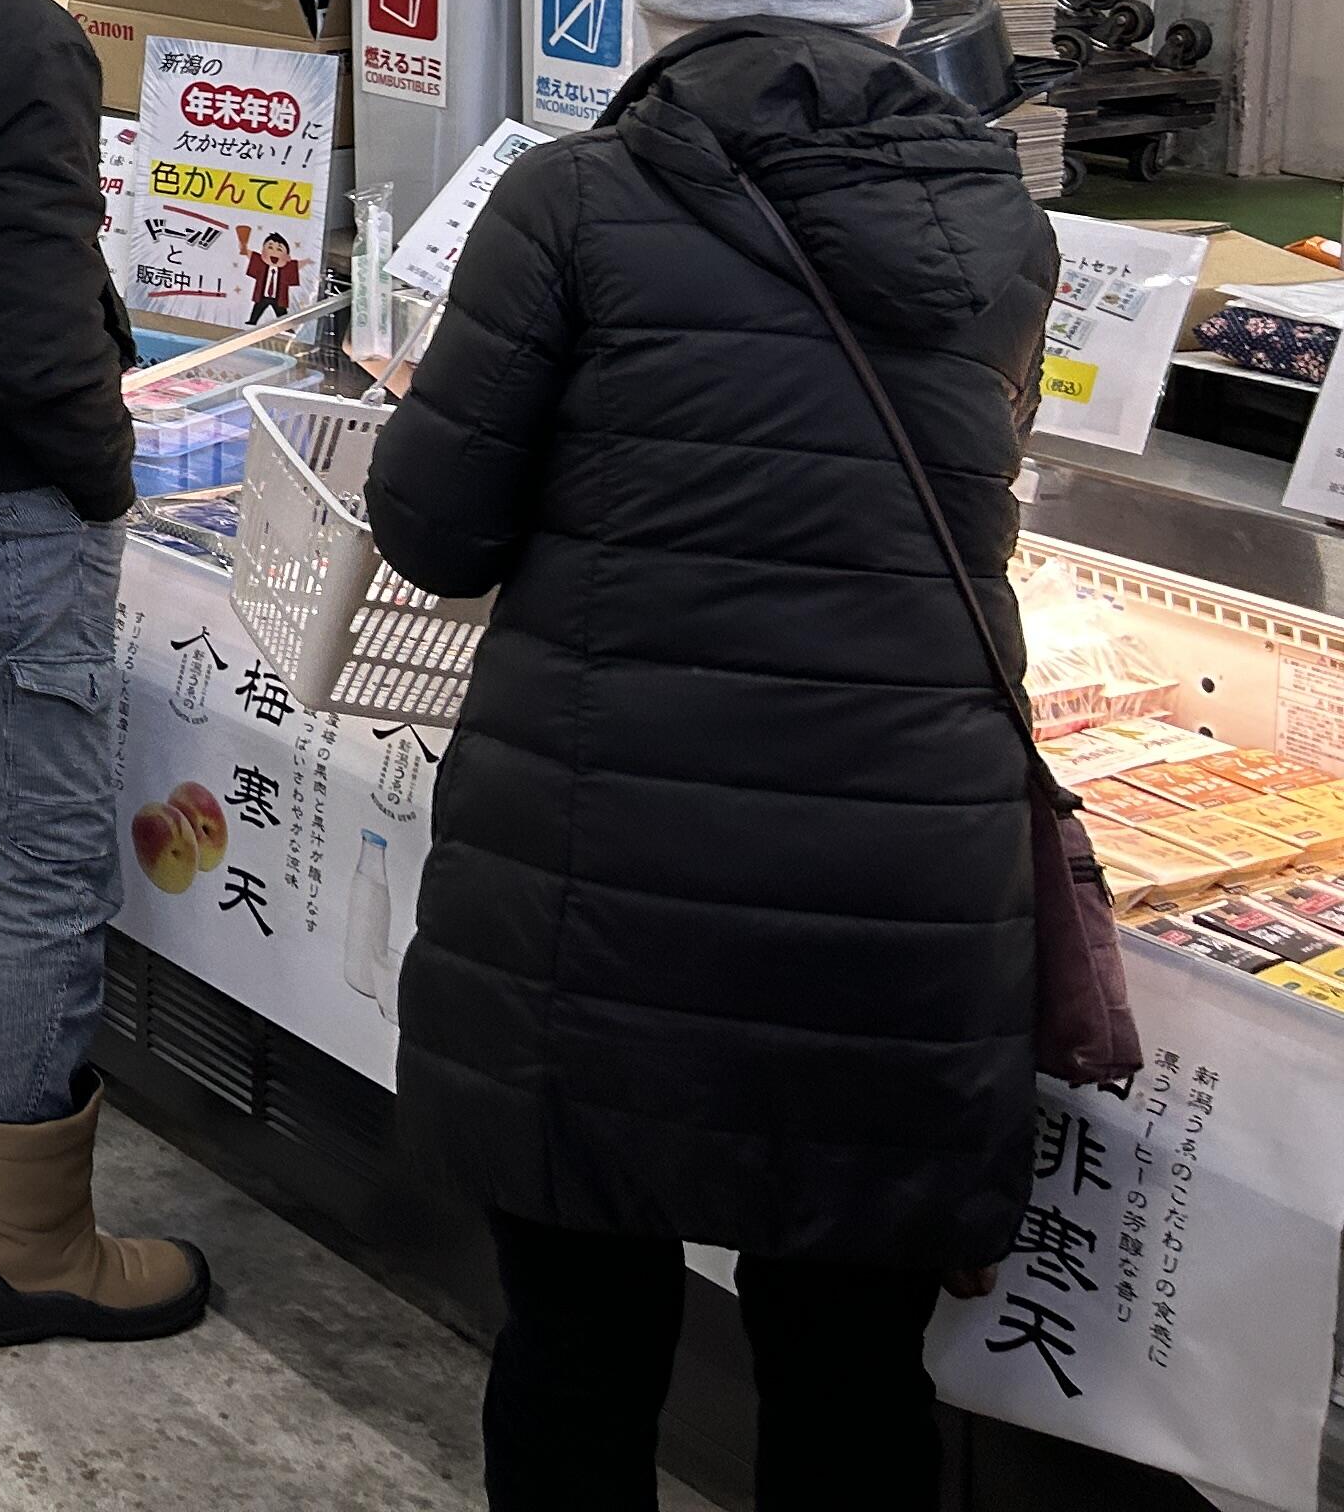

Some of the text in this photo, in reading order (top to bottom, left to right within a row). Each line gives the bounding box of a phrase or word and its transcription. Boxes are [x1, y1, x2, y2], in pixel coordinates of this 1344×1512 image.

[159, 52, 223, 76] 新潟の
[365, 45, 442, 81] 燃えるゴミ
[365, 71, 440, 96] COMBUSTIBLES
[536, 75, 615, 106] 燃えないゴ
[185, 86, 323, 140] 年末年始 に
[174, 130, 313, 170] 欠かせない！！
[152, 160, 311, 216] 色かんてん
[144, 219, 224, 251] ドーン!!
[167, 245, 184, 265] と
[1060, 253, 1132, 277] ートセット
[136, 265, 223, 292] 販売中！！
[218, 659, 295, 937] 梅寒天
[986, 1073, 1136, 1398] 琲寒天
